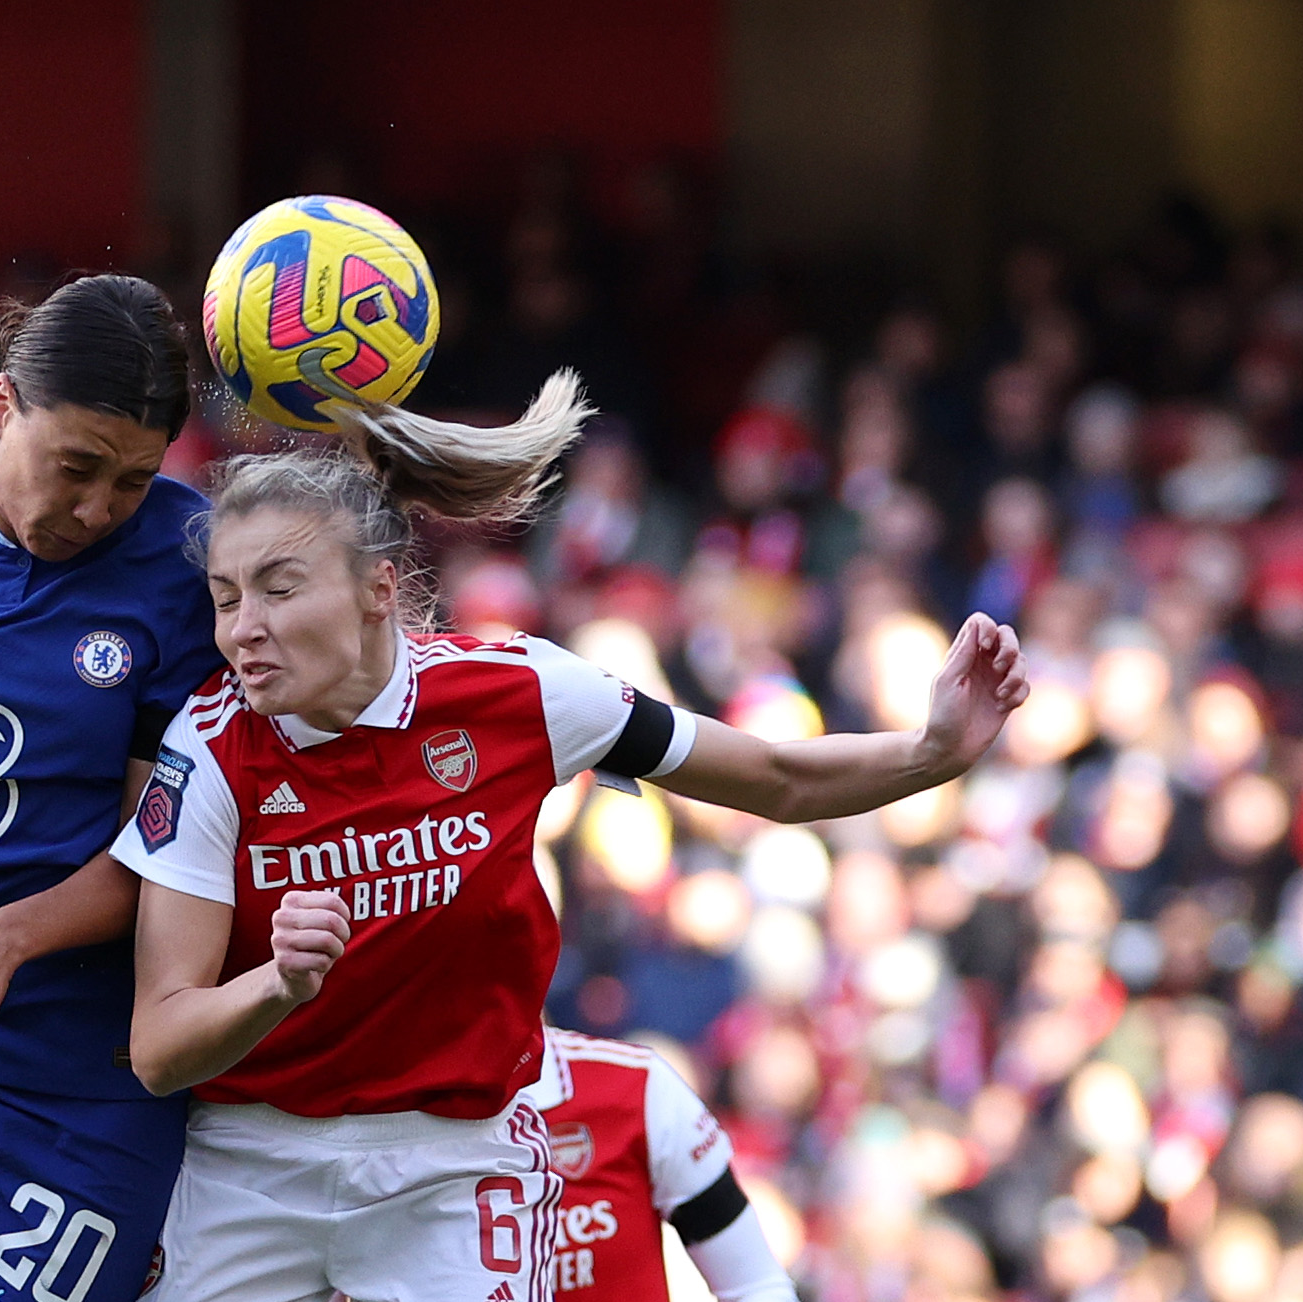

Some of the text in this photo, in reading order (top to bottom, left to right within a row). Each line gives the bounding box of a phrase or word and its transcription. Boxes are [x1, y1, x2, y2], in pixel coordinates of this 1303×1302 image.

[87, 632, 126, 649] CHELSEA
[430, 737, 465, 757] Arsenal
[259, 799, 306, 814] adidas
[248, 811, 491, 890] Emirates
[352, 864, 462, 921] BETTER
[475, 1176, 525, 1274] 6
